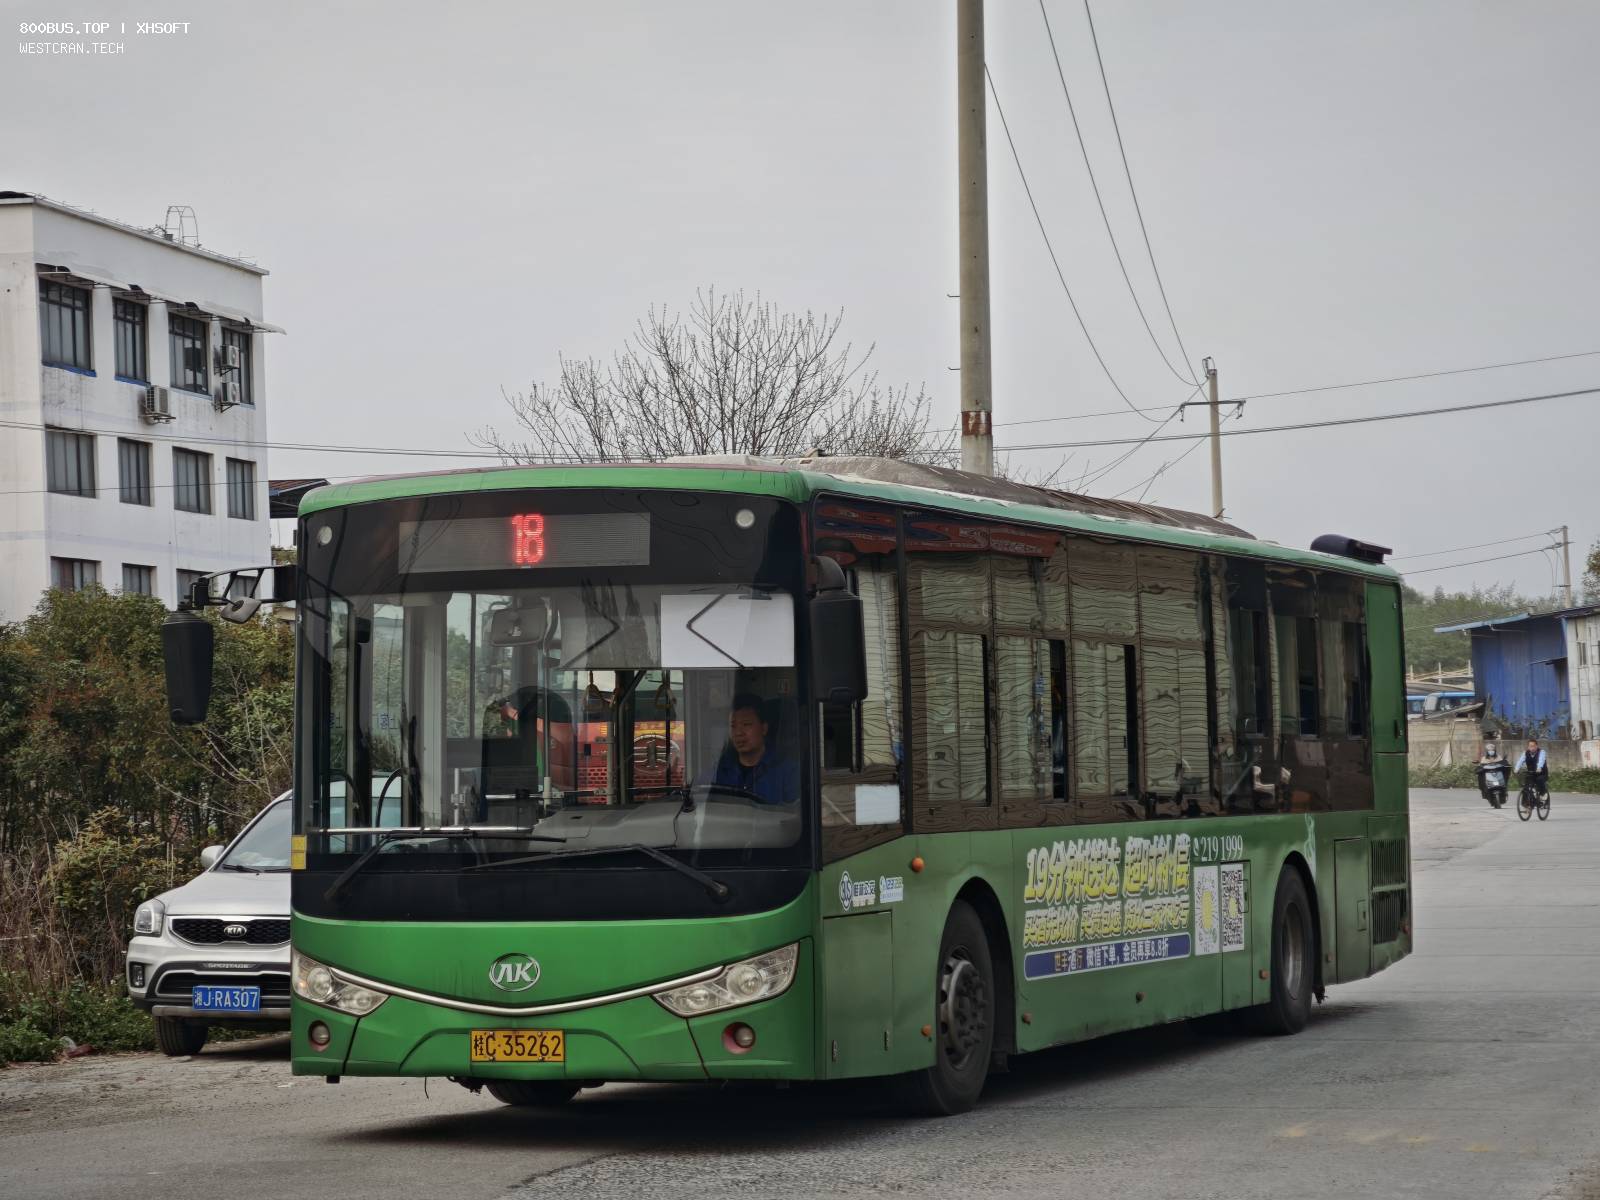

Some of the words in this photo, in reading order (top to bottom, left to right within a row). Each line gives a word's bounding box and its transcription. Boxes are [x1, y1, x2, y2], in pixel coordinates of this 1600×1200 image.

[511, 513, 544, 563] 18
[1200, 836, 1219, 862] 219
[1220, 834, 1243, 861] 1999
